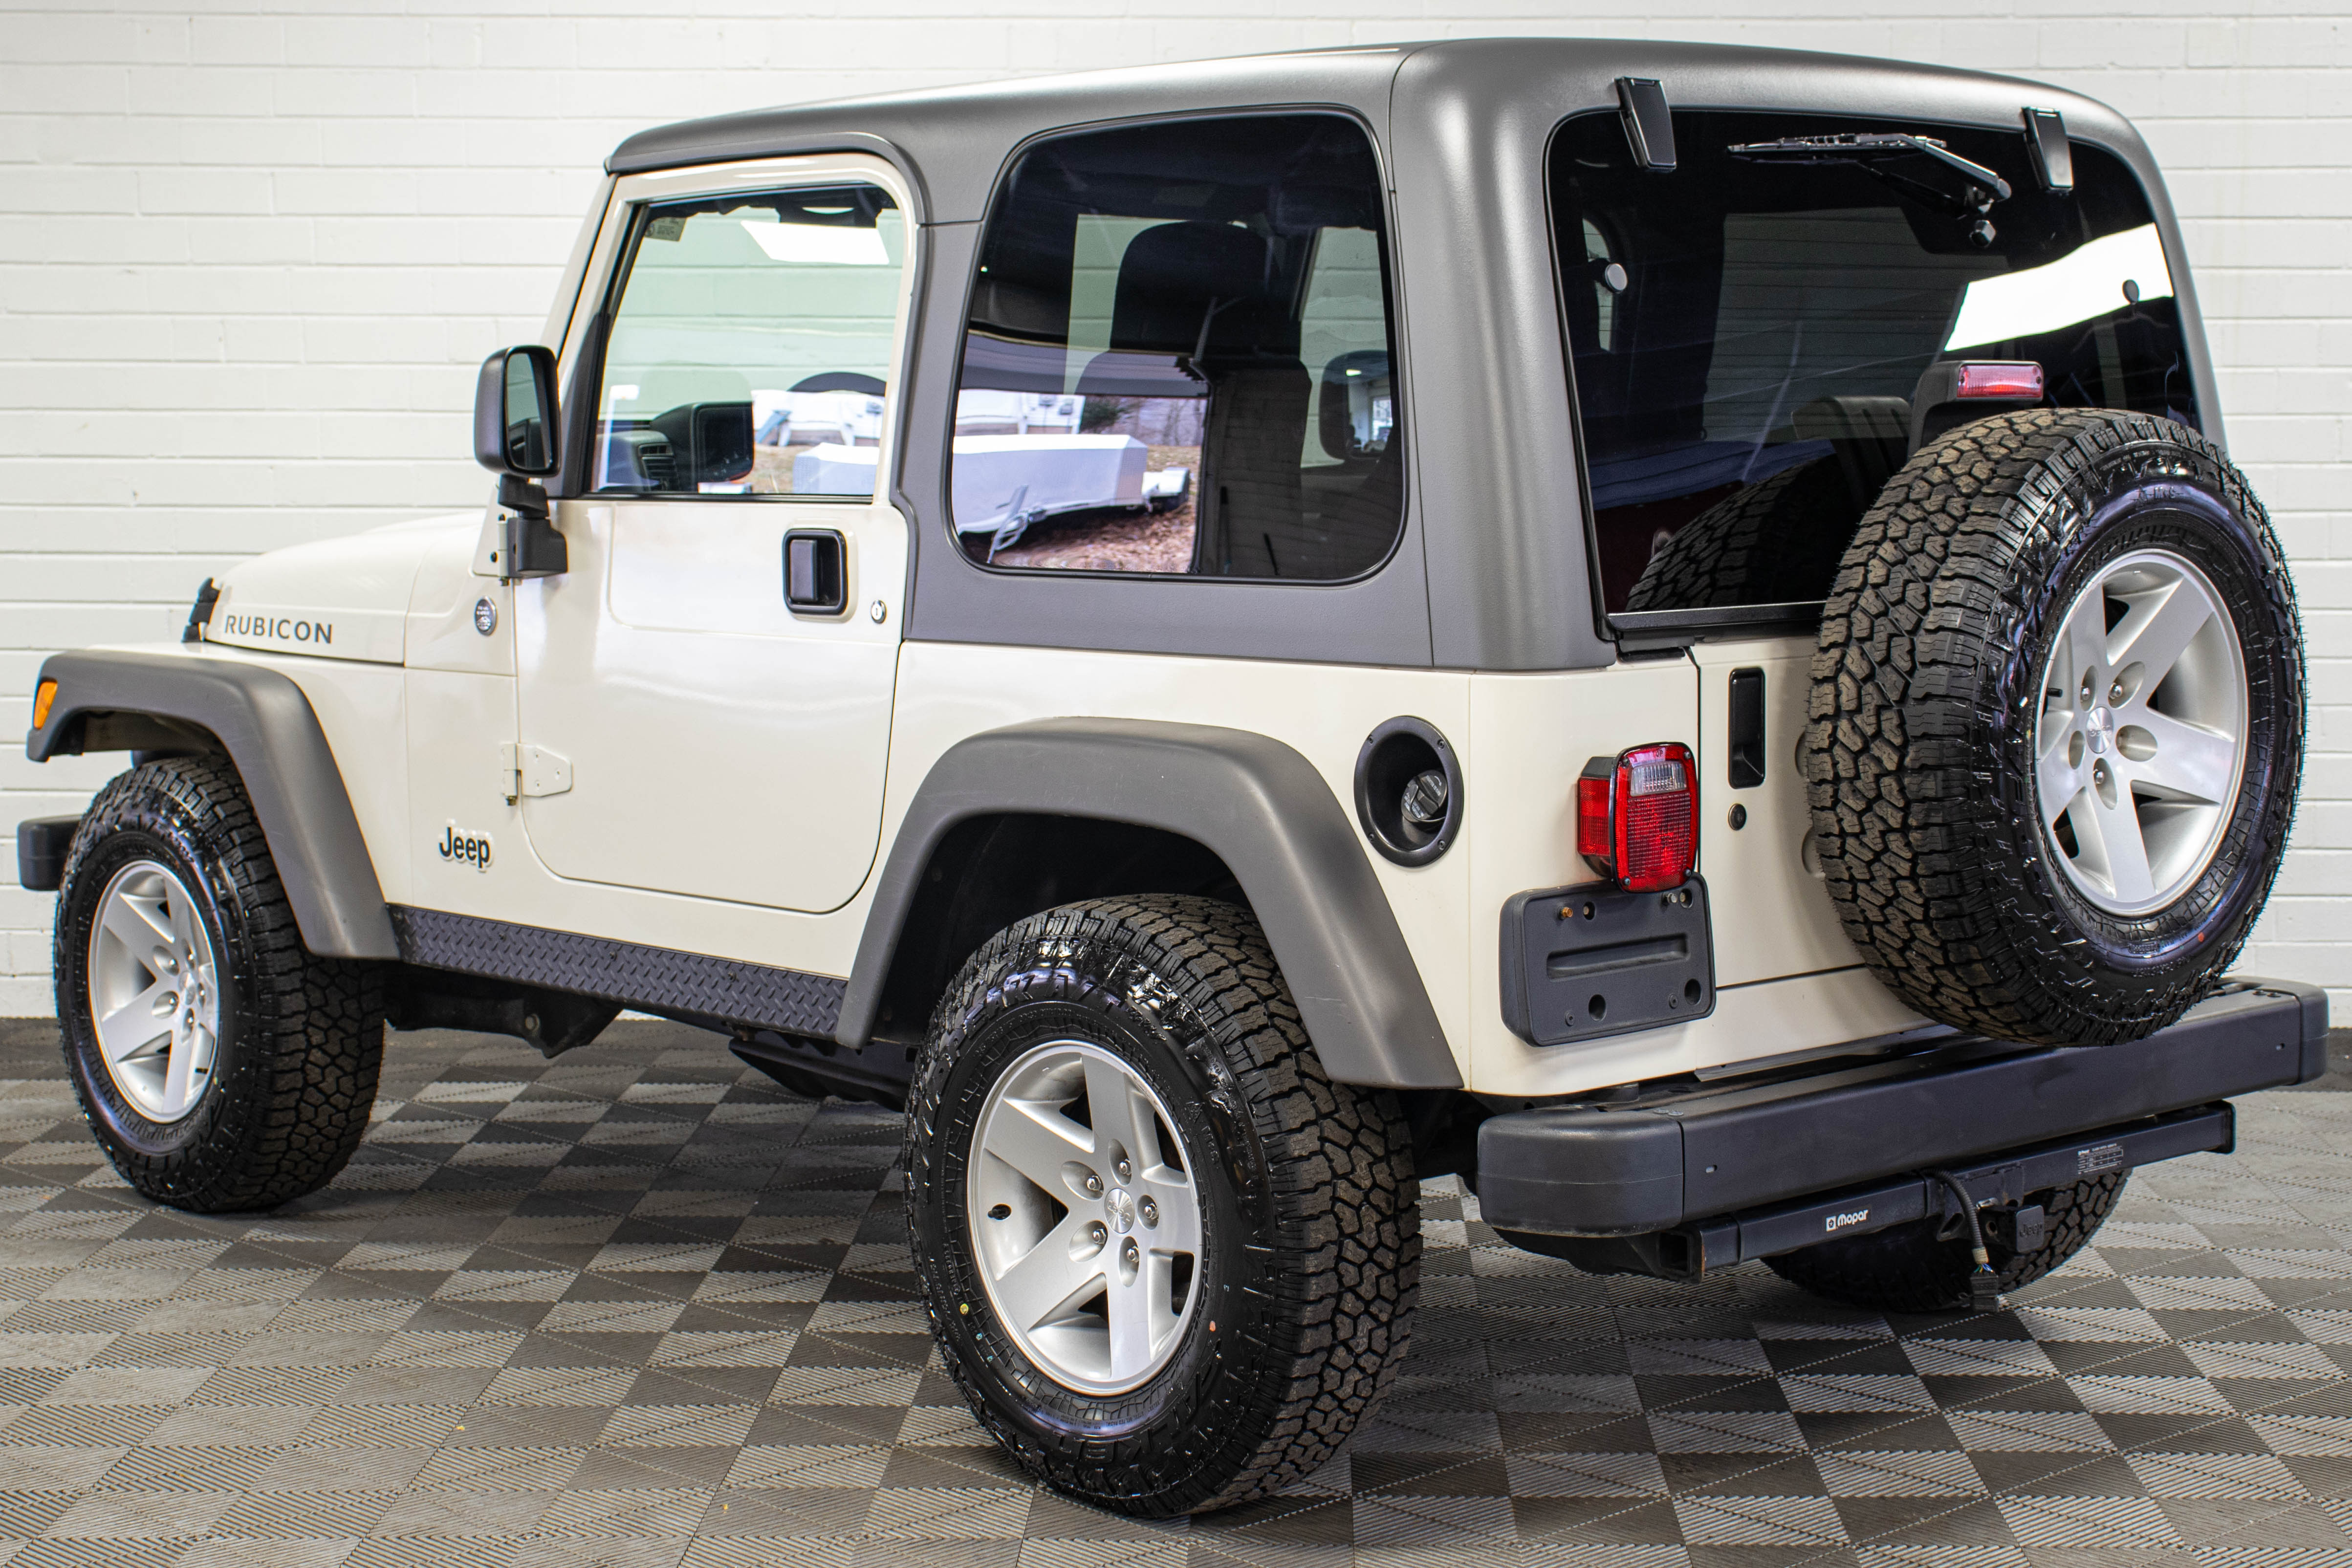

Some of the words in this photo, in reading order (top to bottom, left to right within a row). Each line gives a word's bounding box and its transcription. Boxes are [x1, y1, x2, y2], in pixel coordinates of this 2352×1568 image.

[224, 614, 333, 644] RUBICON
[438, 826, 491, 869] Jeep
[1837, 1209, 1869, 1227] Mopar
